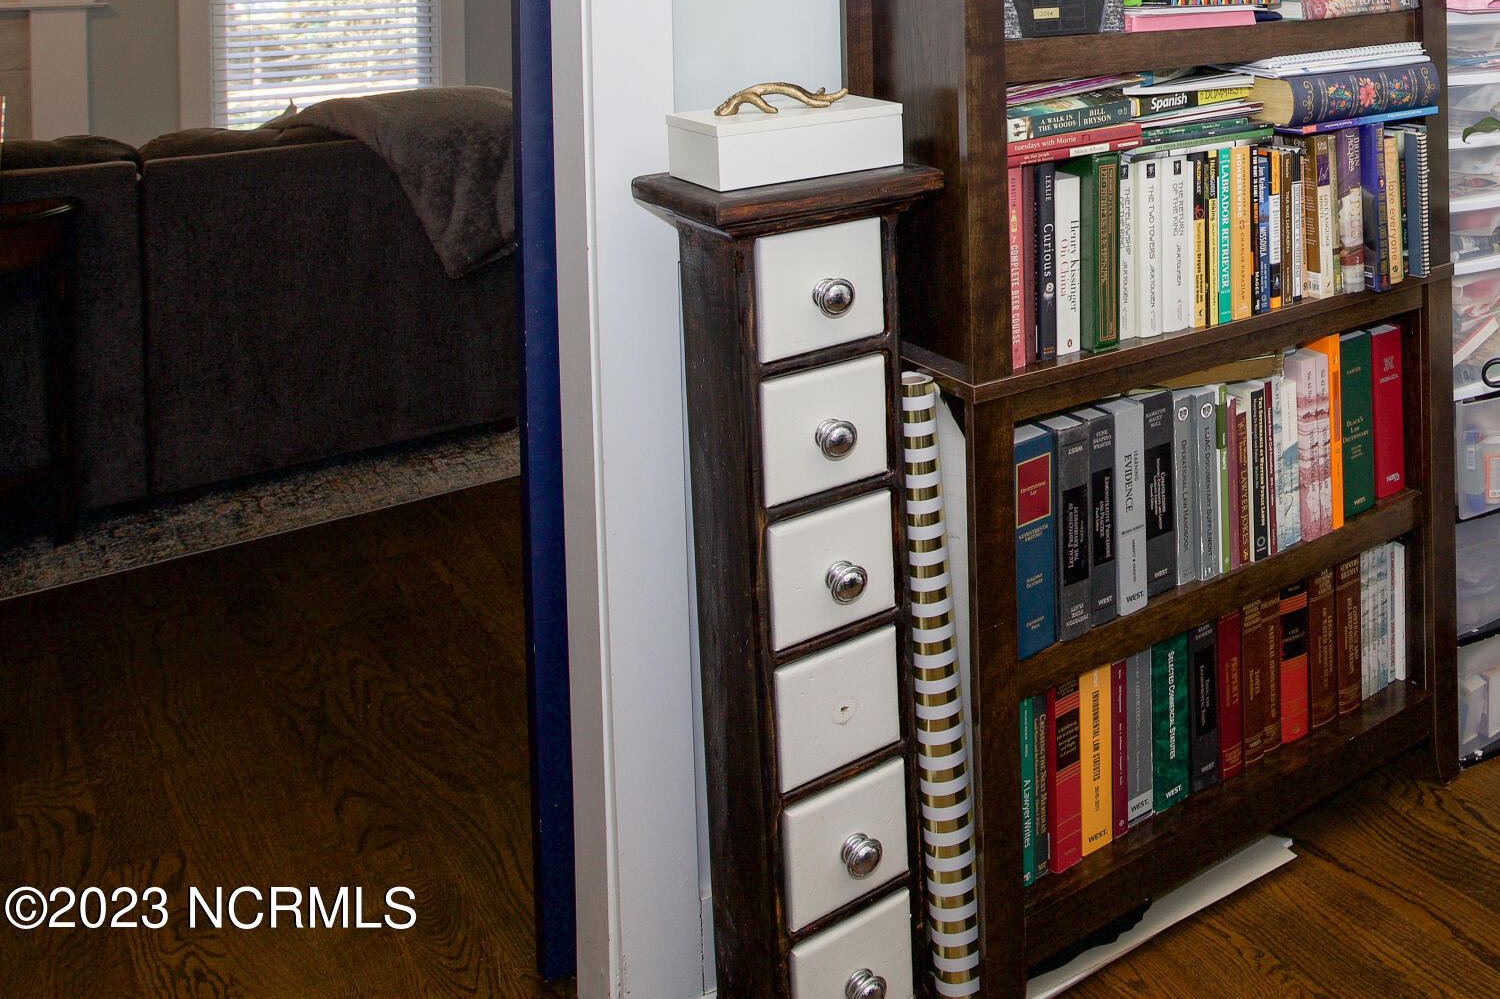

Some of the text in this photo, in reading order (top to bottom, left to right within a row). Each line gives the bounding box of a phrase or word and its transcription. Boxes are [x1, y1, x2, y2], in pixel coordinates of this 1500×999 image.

[1089, 108, 1105, 116] BILL
[1151, 93, 1187, 111] Spanish
[1054, 121, 1076, 130] WOODS
[1083, 114, 1112, 126] BRYSON
[1014, 142, 1040, 151] tuesdays
[1057, 136, 1076, 144] Morrie
[1258, 166, 1266, 176] Jon
[1221, 165, 1230, 288] LABRADOR RETRIEVER
[1388, 180, 1398, 261] love everyone
[1010, 244, 1020, 286] COMPLETE
[1044, 223, 1054, 277] Curious
[1069, 220, 1079, 312] Henry Kissinger
[1060, 262, 1070, 297] China
[1012, 313, 1020, 345] COURSE
[1343, 430, 1369, 443] DICTIONARY
[1124, 455, 1134, 513] EVIDENCE
[1240, 470, 1248, 512] LAWYER
[1092, 690, 1100, 738] ENVIRONMENTAL
[1023, 779, 1030, 787] A
[1022, 788, 1030, 819] Lawyer
